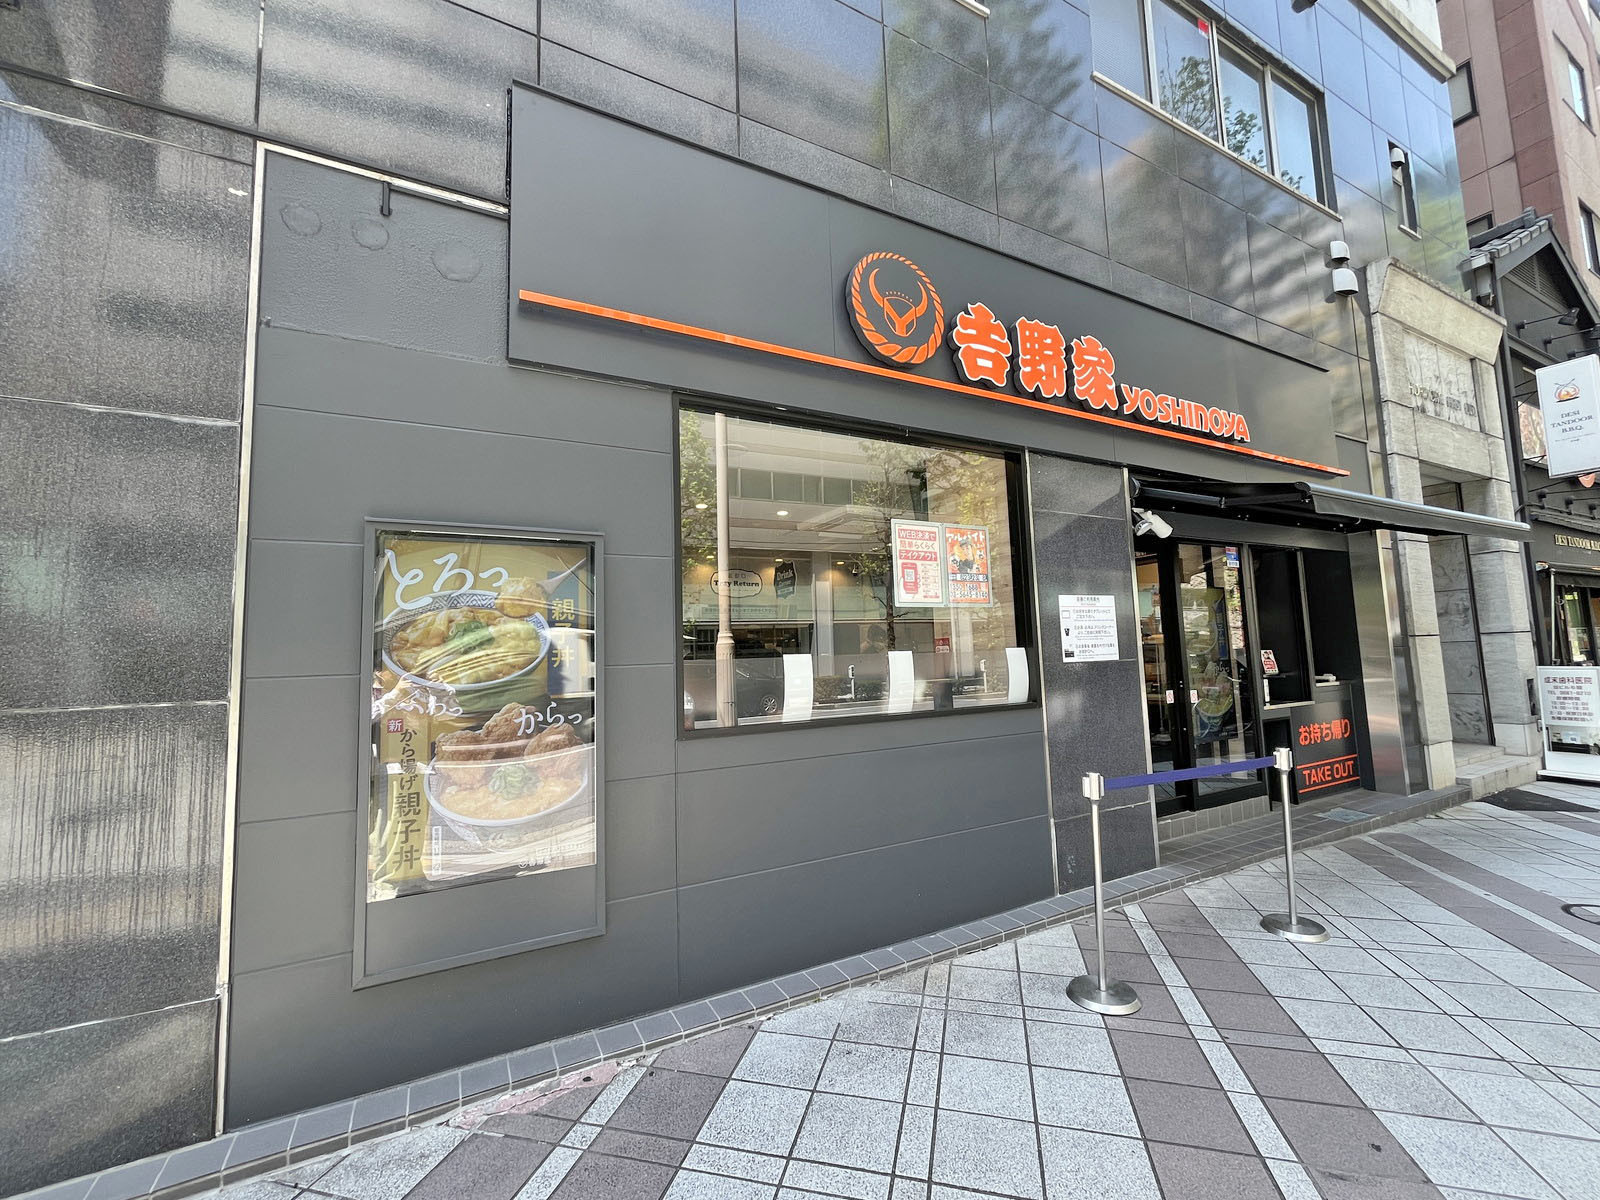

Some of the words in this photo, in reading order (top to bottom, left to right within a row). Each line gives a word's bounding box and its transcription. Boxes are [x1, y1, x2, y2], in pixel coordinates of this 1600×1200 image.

[952, 302, 1119, 410] 吉野家
[1121, 384, 1250, 442] YOSHINOYA
[1550, 415, 1593, 428] TANDOOR
[1560, 410, 1580, 419] DESI
[901, 551, 937, 561] テイクアウト
[385, 548, 509, 610] とろっ
[733, 580, 760, 588] Return
[551, 597, 577, 668] 親子丼
[388, 719, 403, 733] 新
[514, 702, 583, 736] からっ
[1298, 718, 1351, 746] お持ち帰り
[1303, 765, 1332, 786] TAKE
[1333, 760, 1355, 780] OUT
